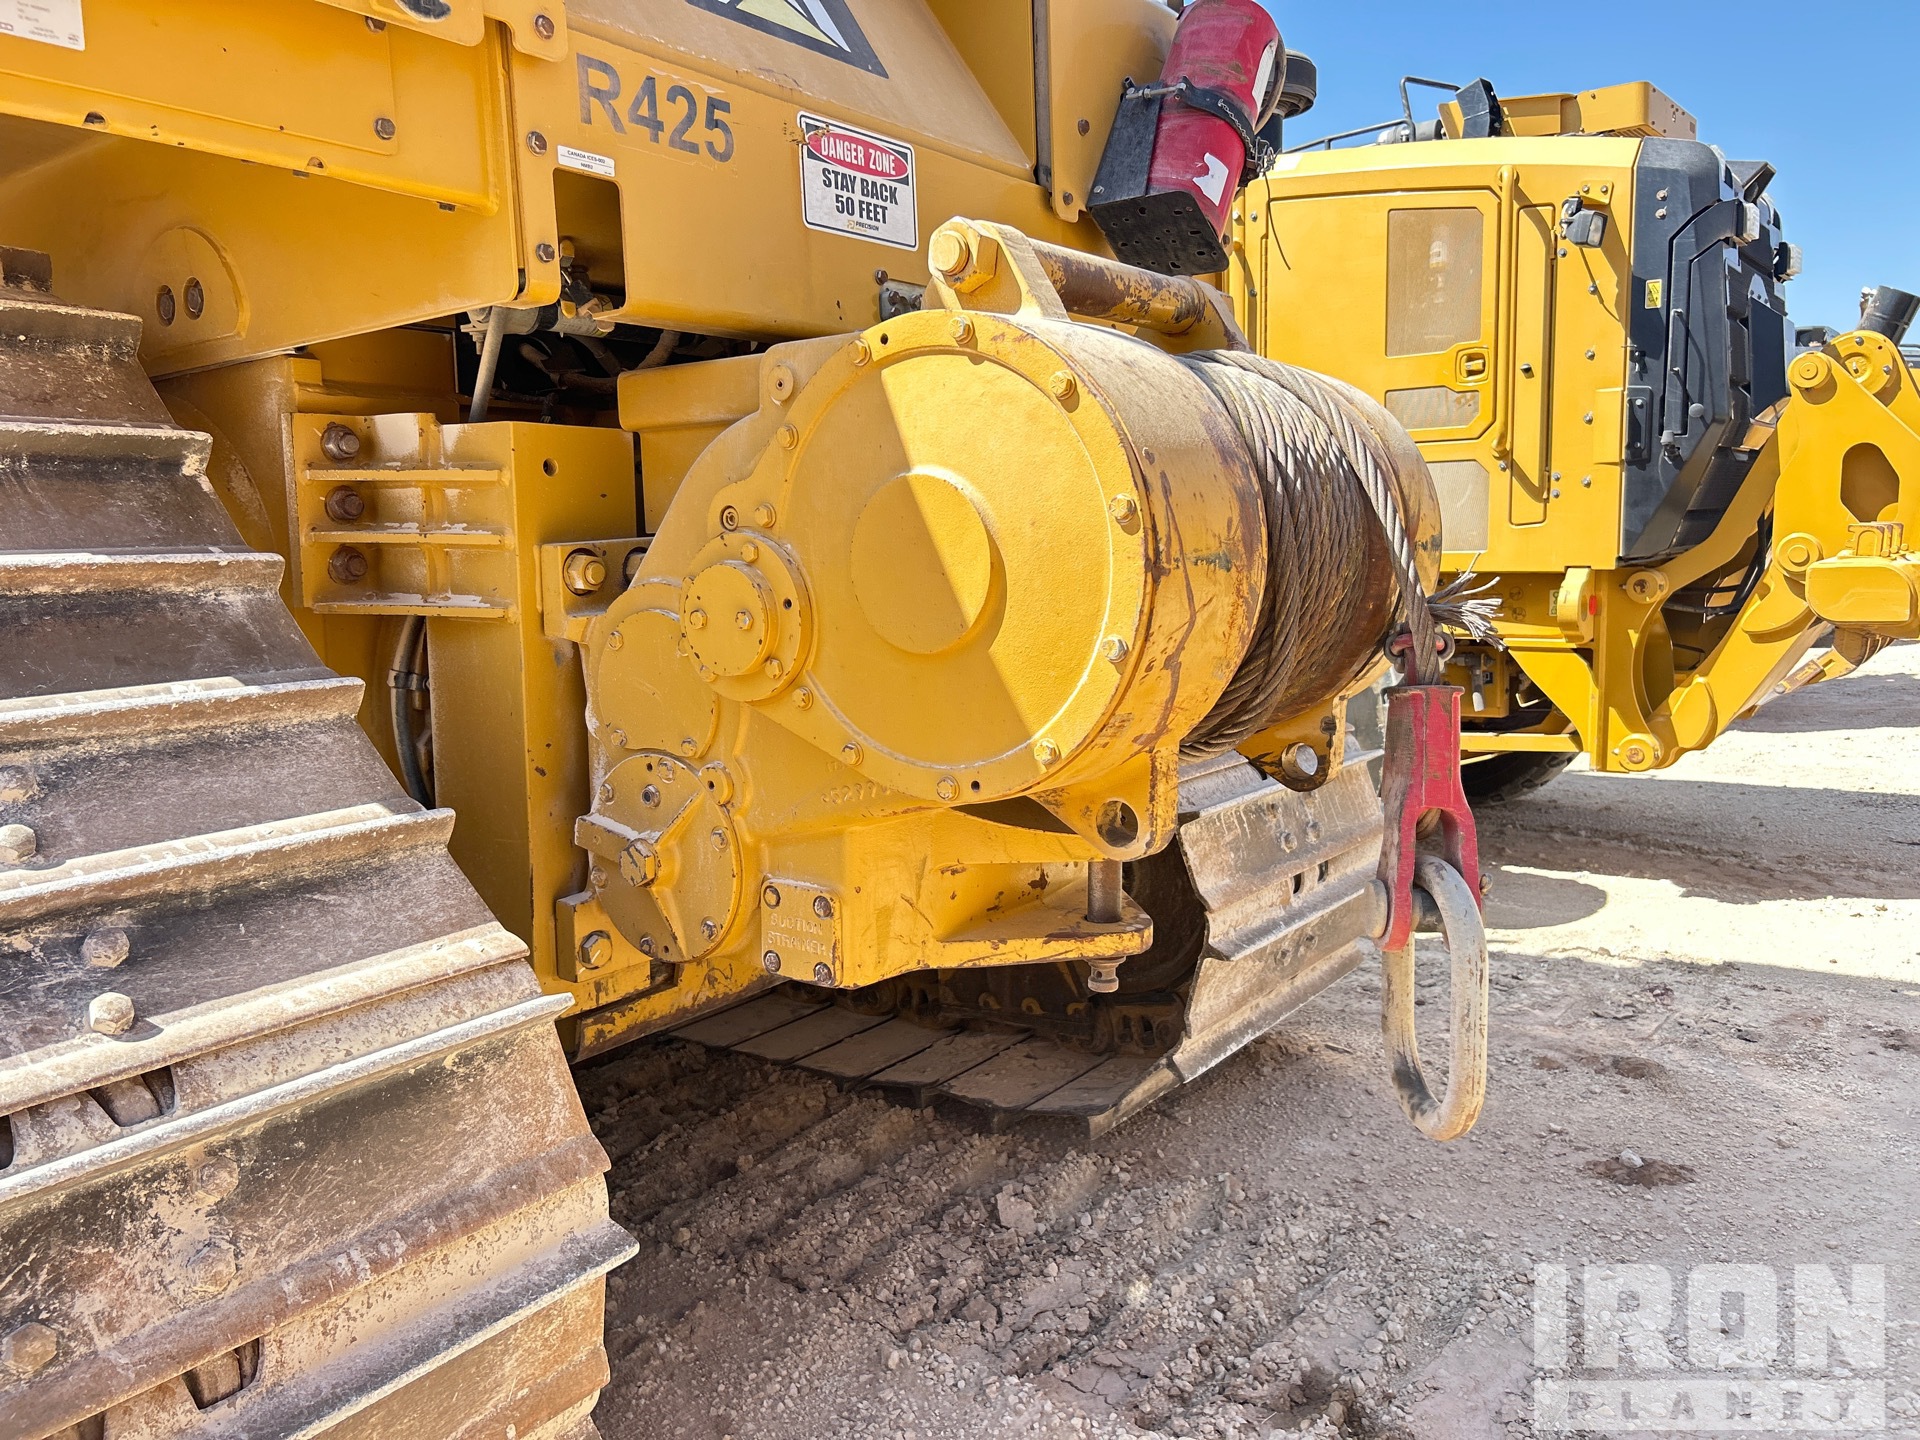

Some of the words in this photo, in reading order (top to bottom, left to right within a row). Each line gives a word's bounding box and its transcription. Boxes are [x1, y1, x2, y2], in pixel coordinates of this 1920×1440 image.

[576, 53, 735, 162] R425
[567, 150, 586, 159] CANADA
[821, 136, 865, 167] DANGER
[869, 148, 896, 175] ZONE
[822, 167, 857, 194] STAY
[860, 177, 899, 205] BACK
[835, 194, 855, 216] 50
[858, 200, 888, 224] FEET
[855, 220, 880, 231] PRECISION
[770, 912, 823, 935] SUCTION
[767, 930, 827, 956] STRAINER
